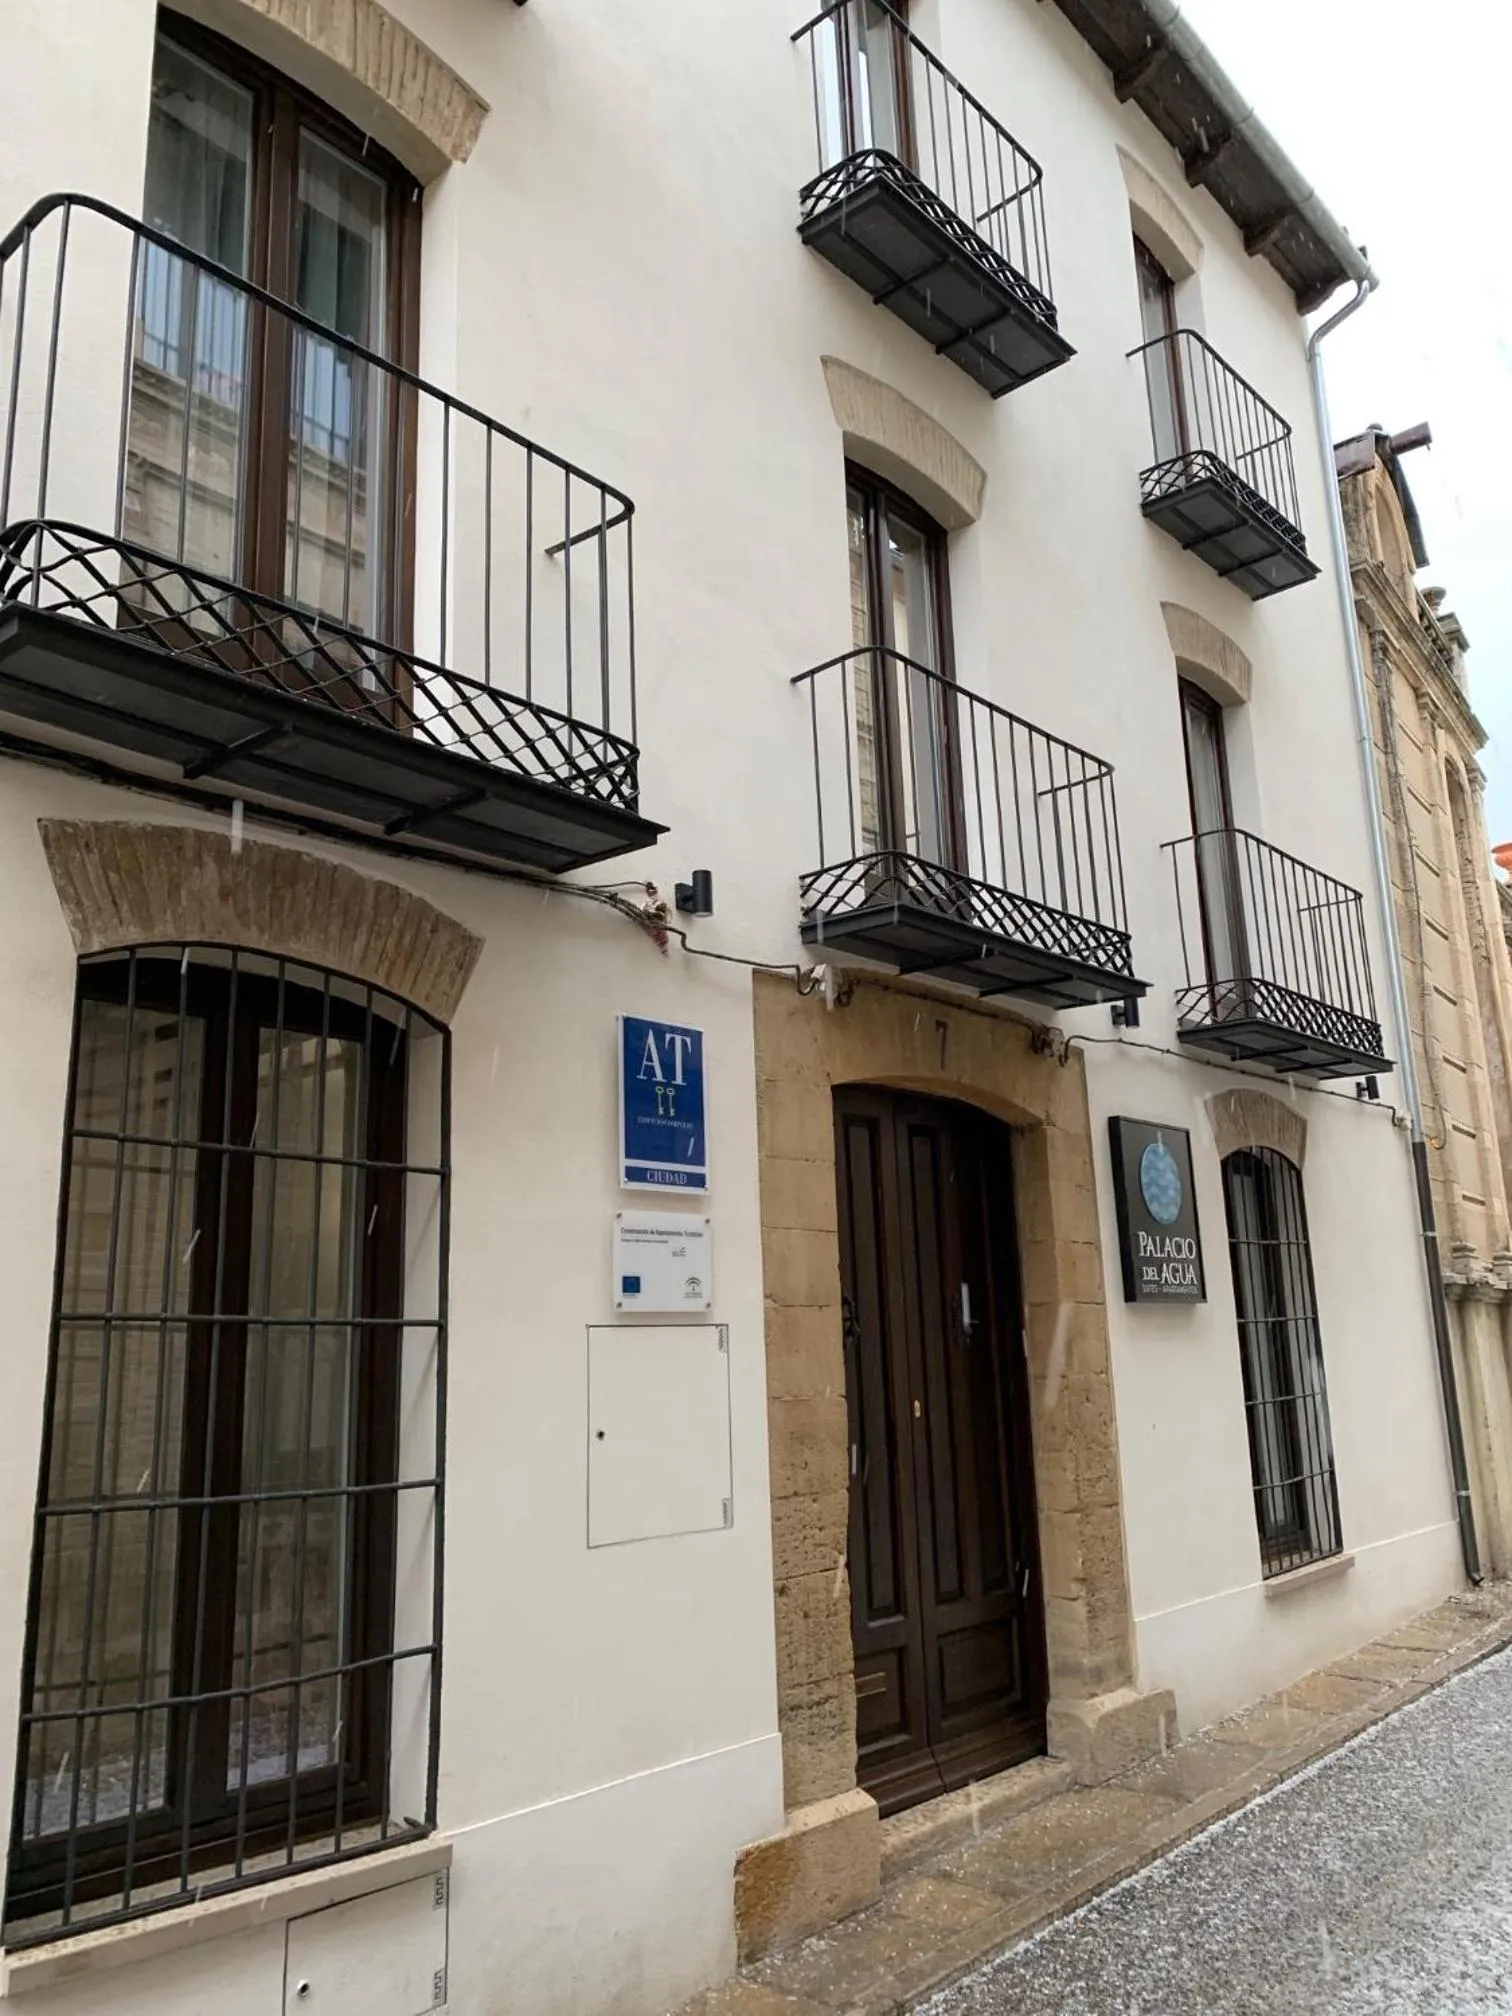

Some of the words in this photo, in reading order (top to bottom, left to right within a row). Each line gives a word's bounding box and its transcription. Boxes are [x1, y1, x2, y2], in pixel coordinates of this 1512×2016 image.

[636, 1027, 692, 1086] AT
[646, 1169, 688, 1185] CIUDAD
[1137, 1231, 1196, 1259] PALACIO
[1143, 1266, 1160, 1281] DEL
[1160, 1262, 1198, 1285] AGUA
